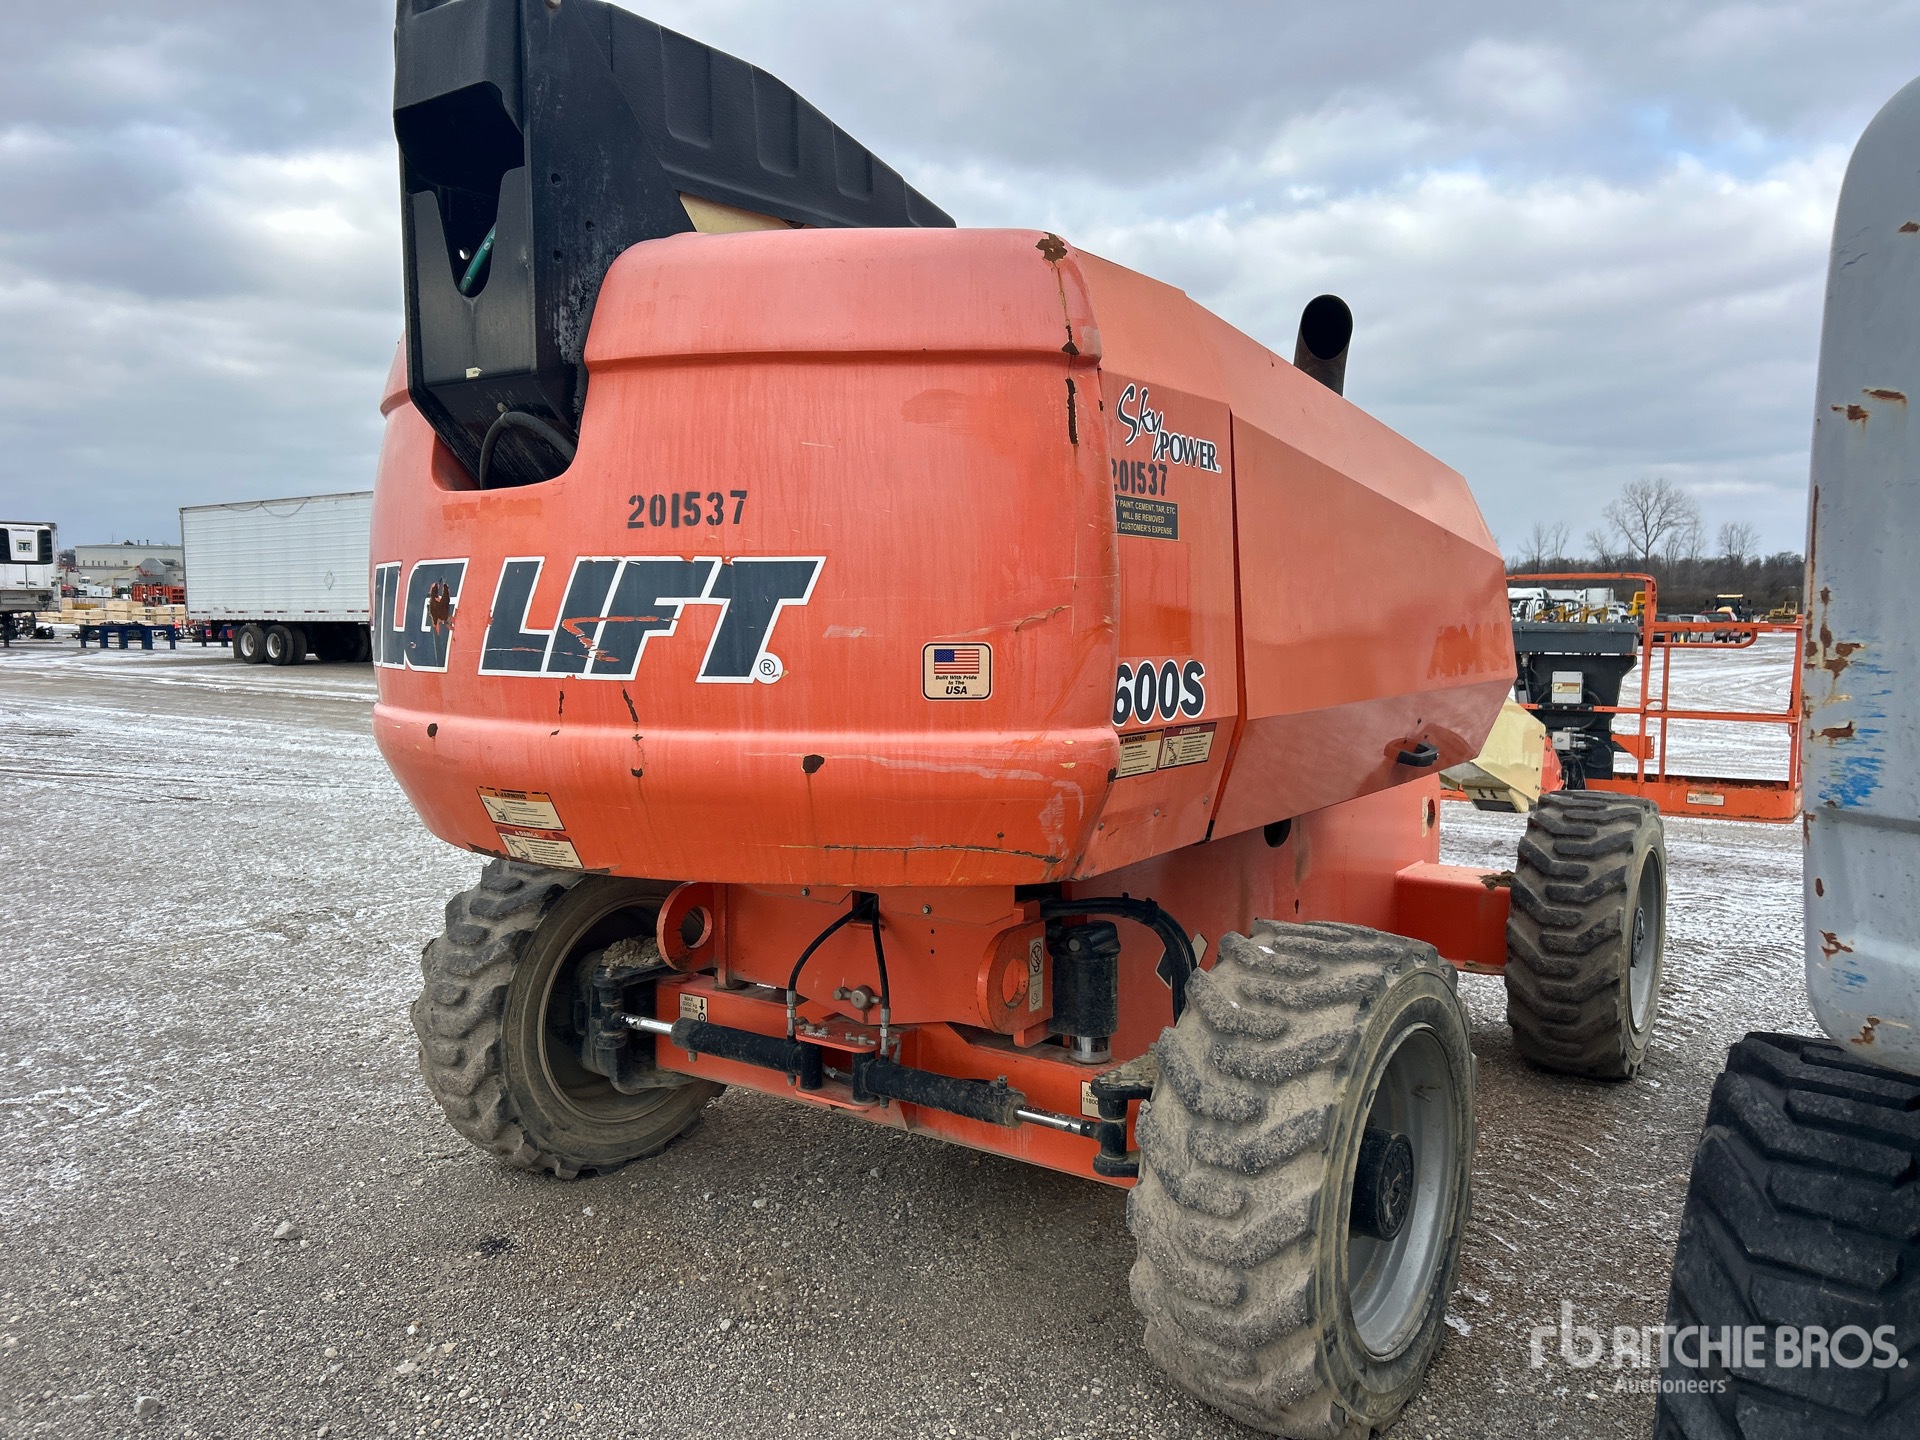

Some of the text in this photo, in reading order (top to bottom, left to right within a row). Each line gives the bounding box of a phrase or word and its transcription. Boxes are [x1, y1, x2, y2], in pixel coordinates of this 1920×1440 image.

[1117, 383, 1163, 461] Sky
[626, 490, 748, 529] 201537
[1121, 522, 1152, 533] CUSTOMER'S
[1152, 526, 1173, 536] EXPENSE
[1122, 512, 1165, 524] WILL BE REMOVED
[478, 555, 827, 685] LIFT
[946, 686, 967, 694] USA
[1112, 659, 1205, 727] 600S
